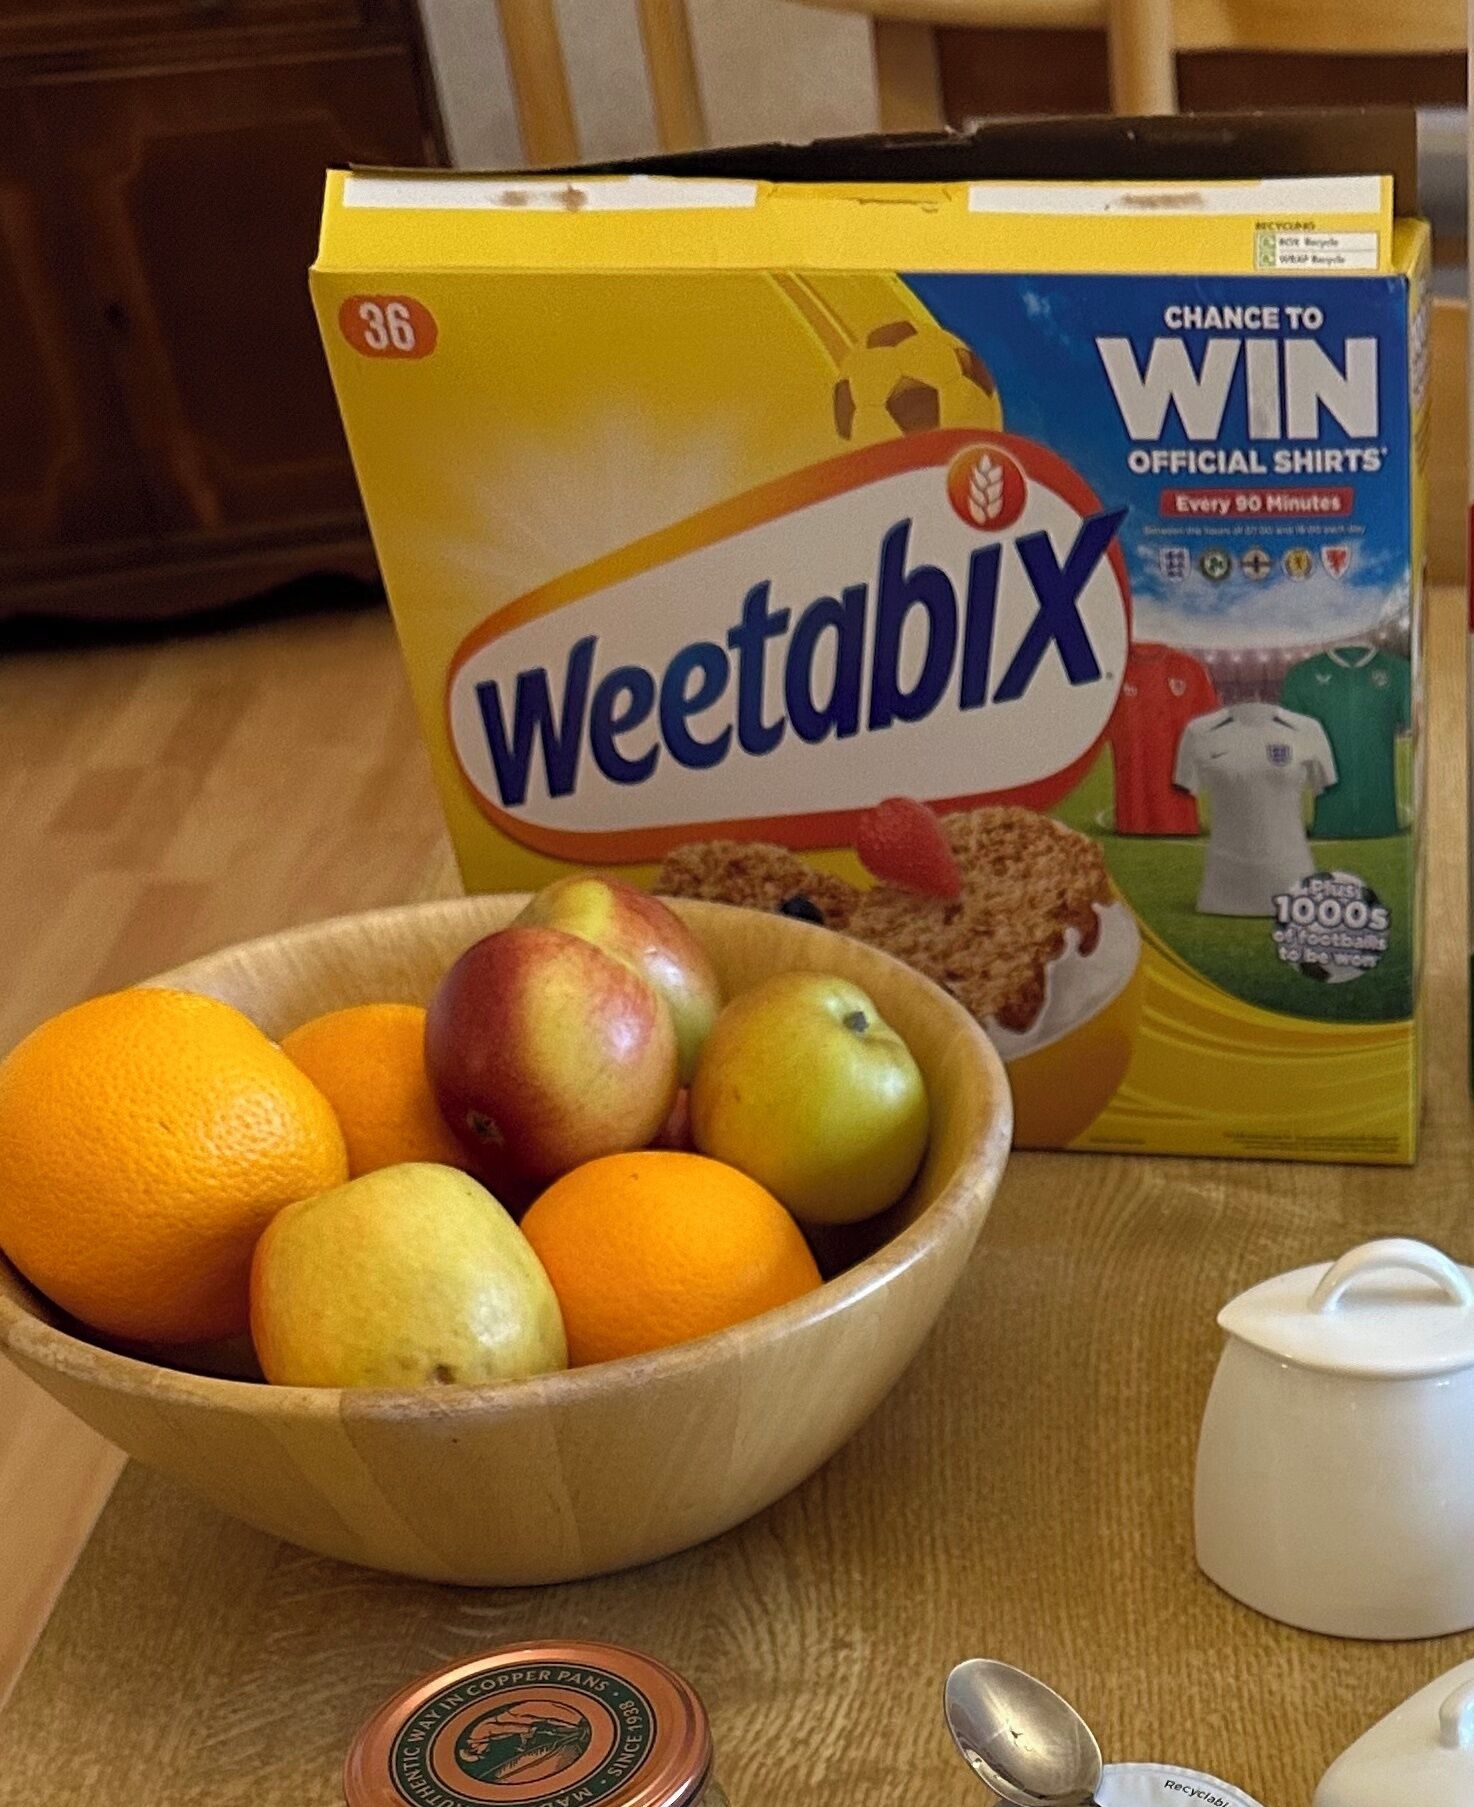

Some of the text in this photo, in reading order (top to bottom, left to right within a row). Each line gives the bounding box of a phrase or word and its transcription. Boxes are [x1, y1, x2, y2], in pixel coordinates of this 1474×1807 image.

[360, 302, 416, 352] 36
[1164, 305, 1324, 330] CHANCE TO
[1095, 336, 1378, 441] WIN
[1128, 450, 1267, 474] OFFICIAL
[1175, 494, 1341, 515] Every 90 Minutes
[476, 506, 1129, 807] Weetabix
[1277, 895, 1390, 930] 1000s
[1273, 928, 1389, 951] of footballs
[1279, 946, 1299, 961] to
[1304, 947, 1329, 965] be
[410, 1712, 442, 1746] WAY
[439, 1694, 465, 1711] IN
[467, 1670, 551, 1697] COPPER
[558, 1670, 610, 1692] PANS
[608, 1700, 643, 1777] SINCE 1938
